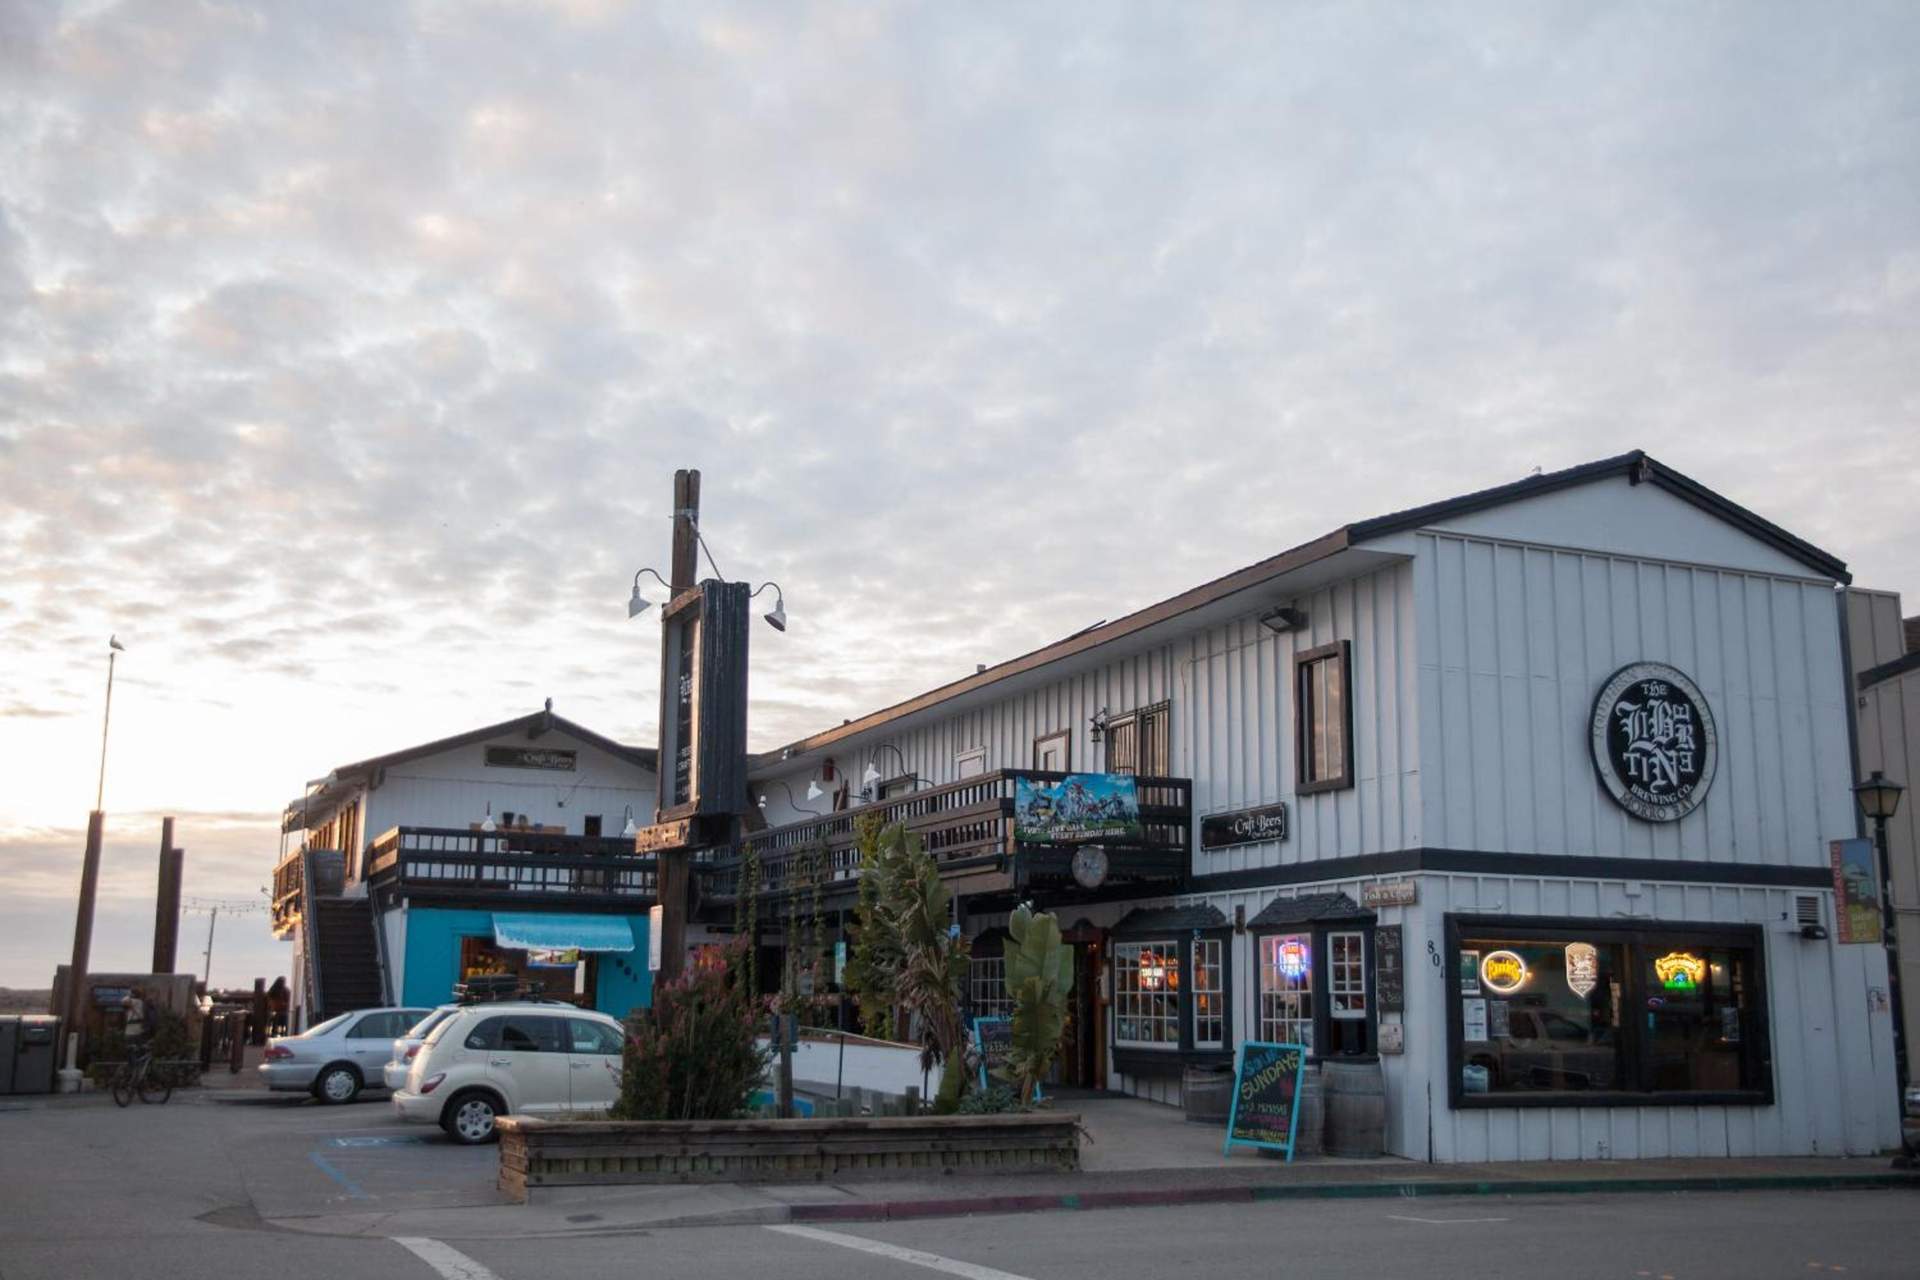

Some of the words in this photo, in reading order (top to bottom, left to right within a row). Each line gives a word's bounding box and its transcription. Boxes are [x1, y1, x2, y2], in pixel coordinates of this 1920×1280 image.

[1642, 681, 1668, 696] THE
[1630, 784, 1677, 805] BREWING
[1677, 783, 1694, 798] CO.
[1234, 816, 1255, 836] Craft
[1256, 814, 1281, 832] Beers
[1241, 1050, 1300, 1100] SUNDAYS
